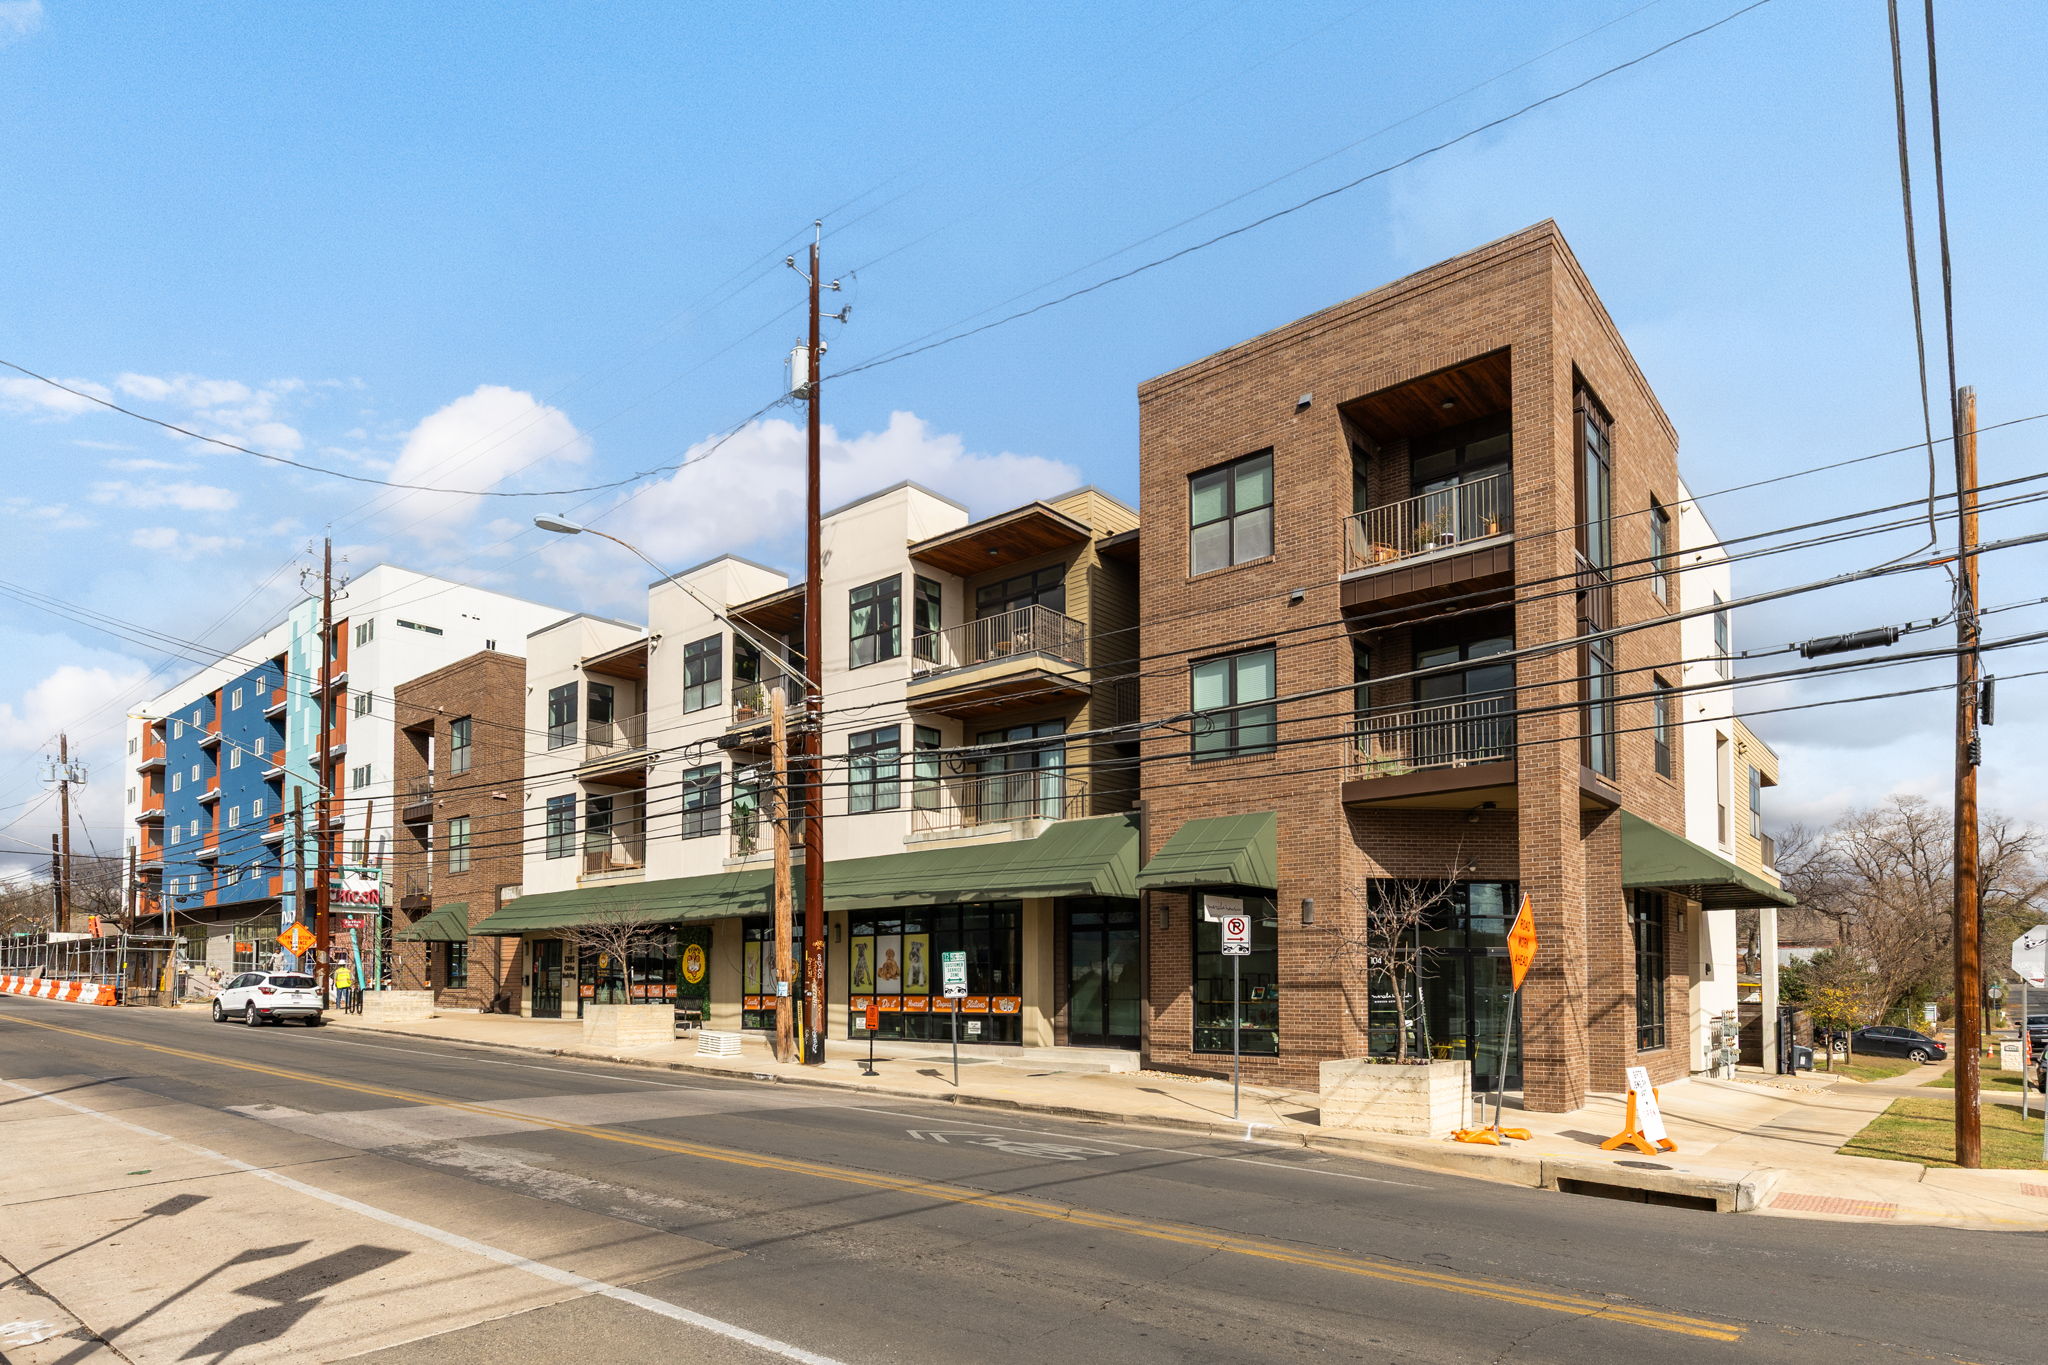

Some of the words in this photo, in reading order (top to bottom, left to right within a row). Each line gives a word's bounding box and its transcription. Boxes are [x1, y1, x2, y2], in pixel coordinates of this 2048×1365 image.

[1520, 918, 1531, 932] ROAD
[1518, 936, 1529, 949] WORK
[1370, 956, 1382, 965] 104
[1514, 954, 1529, 967] AHEAD
